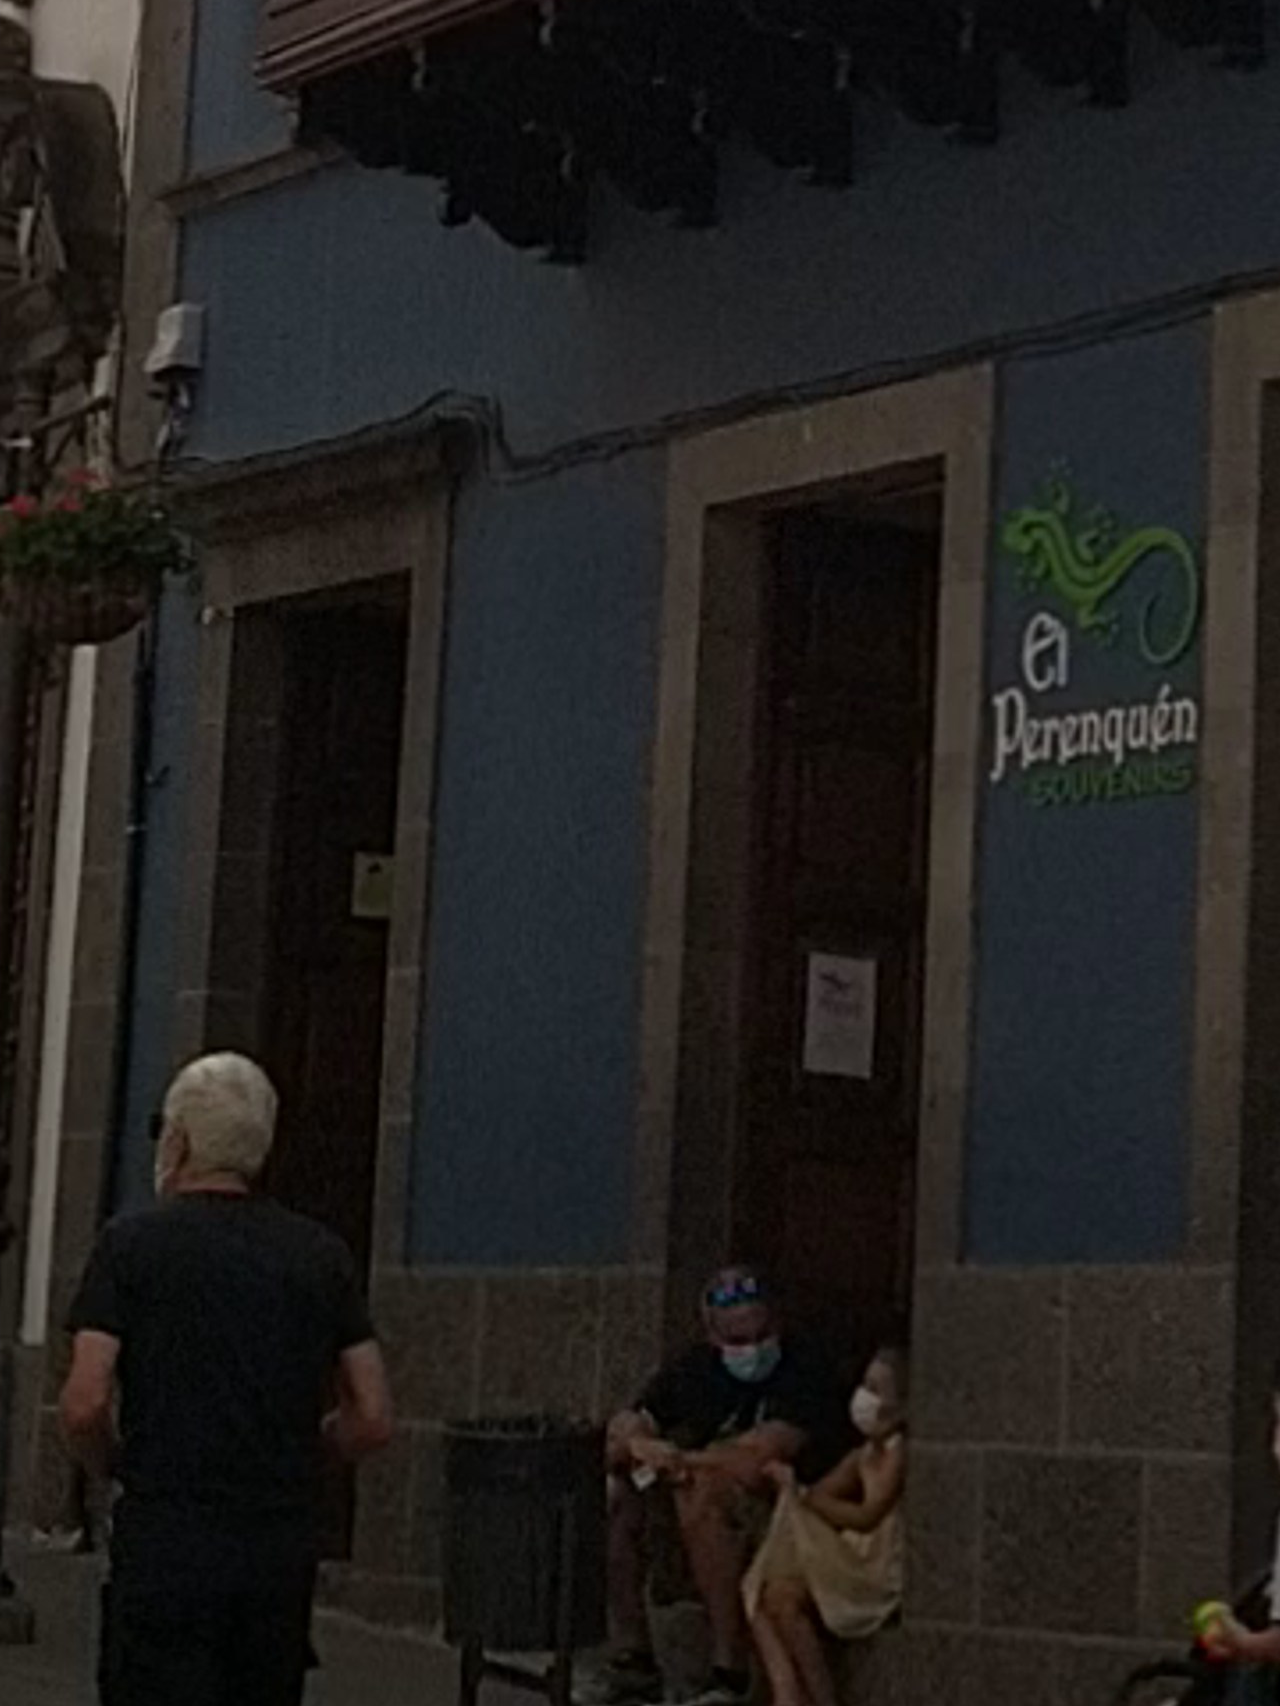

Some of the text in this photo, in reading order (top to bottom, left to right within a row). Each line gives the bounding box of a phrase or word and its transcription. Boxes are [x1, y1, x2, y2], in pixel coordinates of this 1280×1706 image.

[1022, 610, 1069, 691] El
[988, 683, 1198, 783] Perenquén
[1030, 761, 1192, 806] SOUVENIRS
